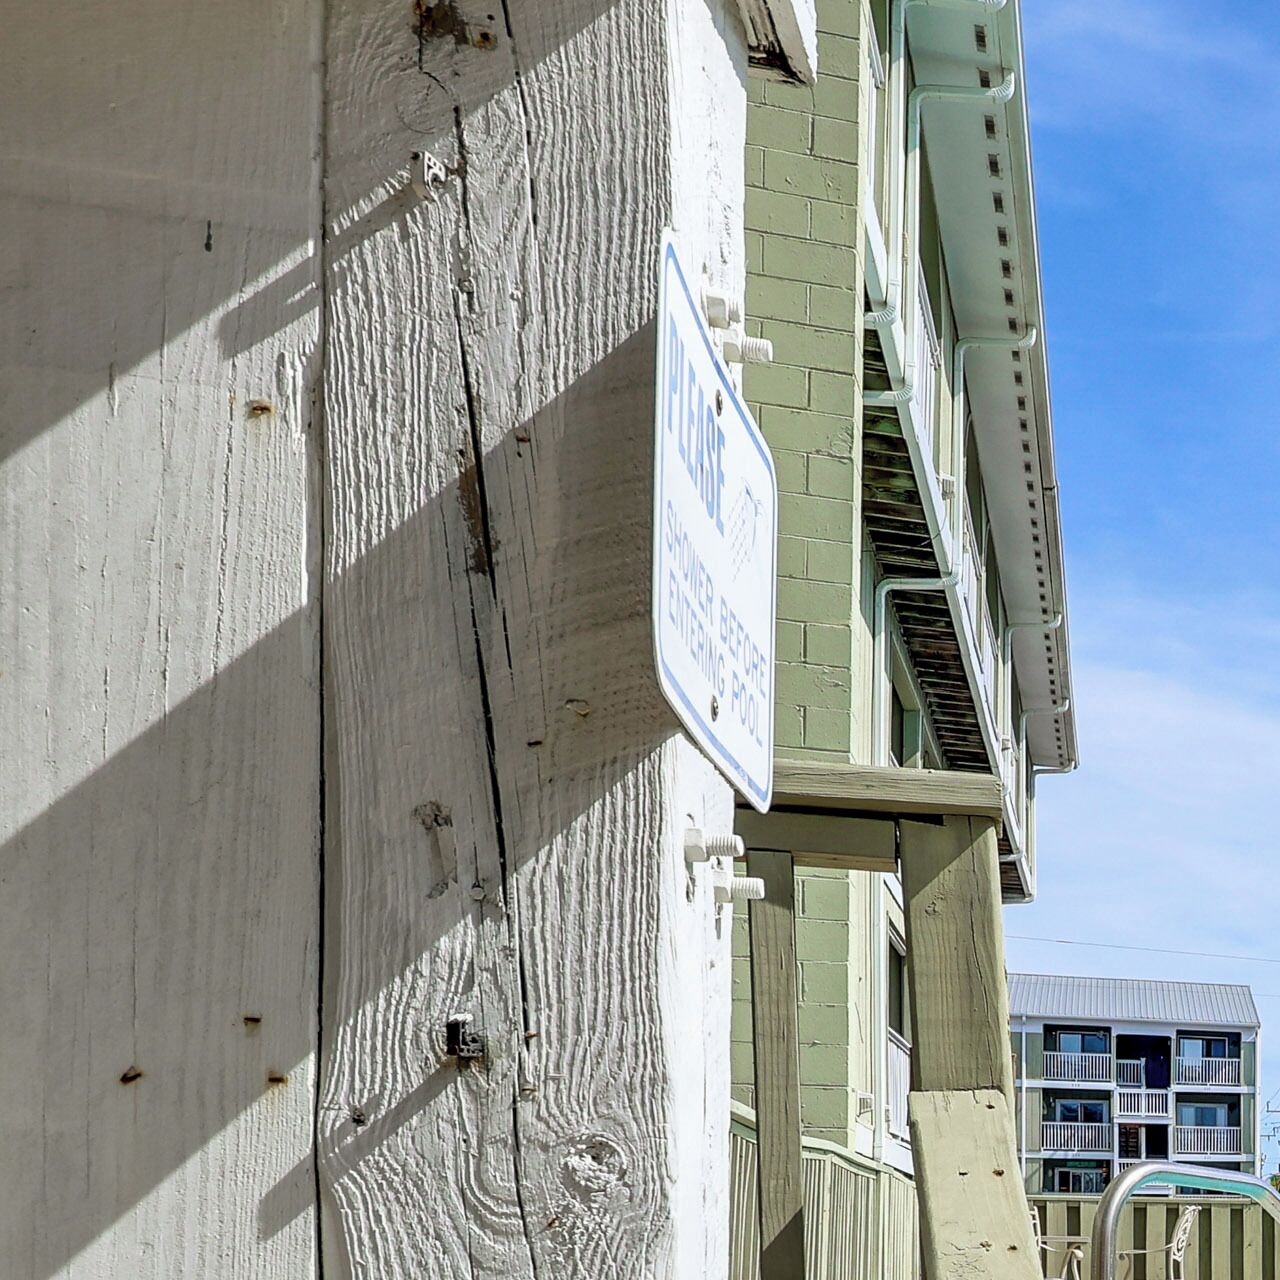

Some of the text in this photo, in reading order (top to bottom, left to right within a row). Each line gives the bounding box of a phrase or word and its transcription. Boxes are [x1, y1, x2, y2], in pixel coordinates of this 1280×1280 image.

[667, 312, 726, 538] PLEASE
[666, 499, 767, 699] SHOWER BEFORE
[668, 567, 763, 748] ENTERING POOL
